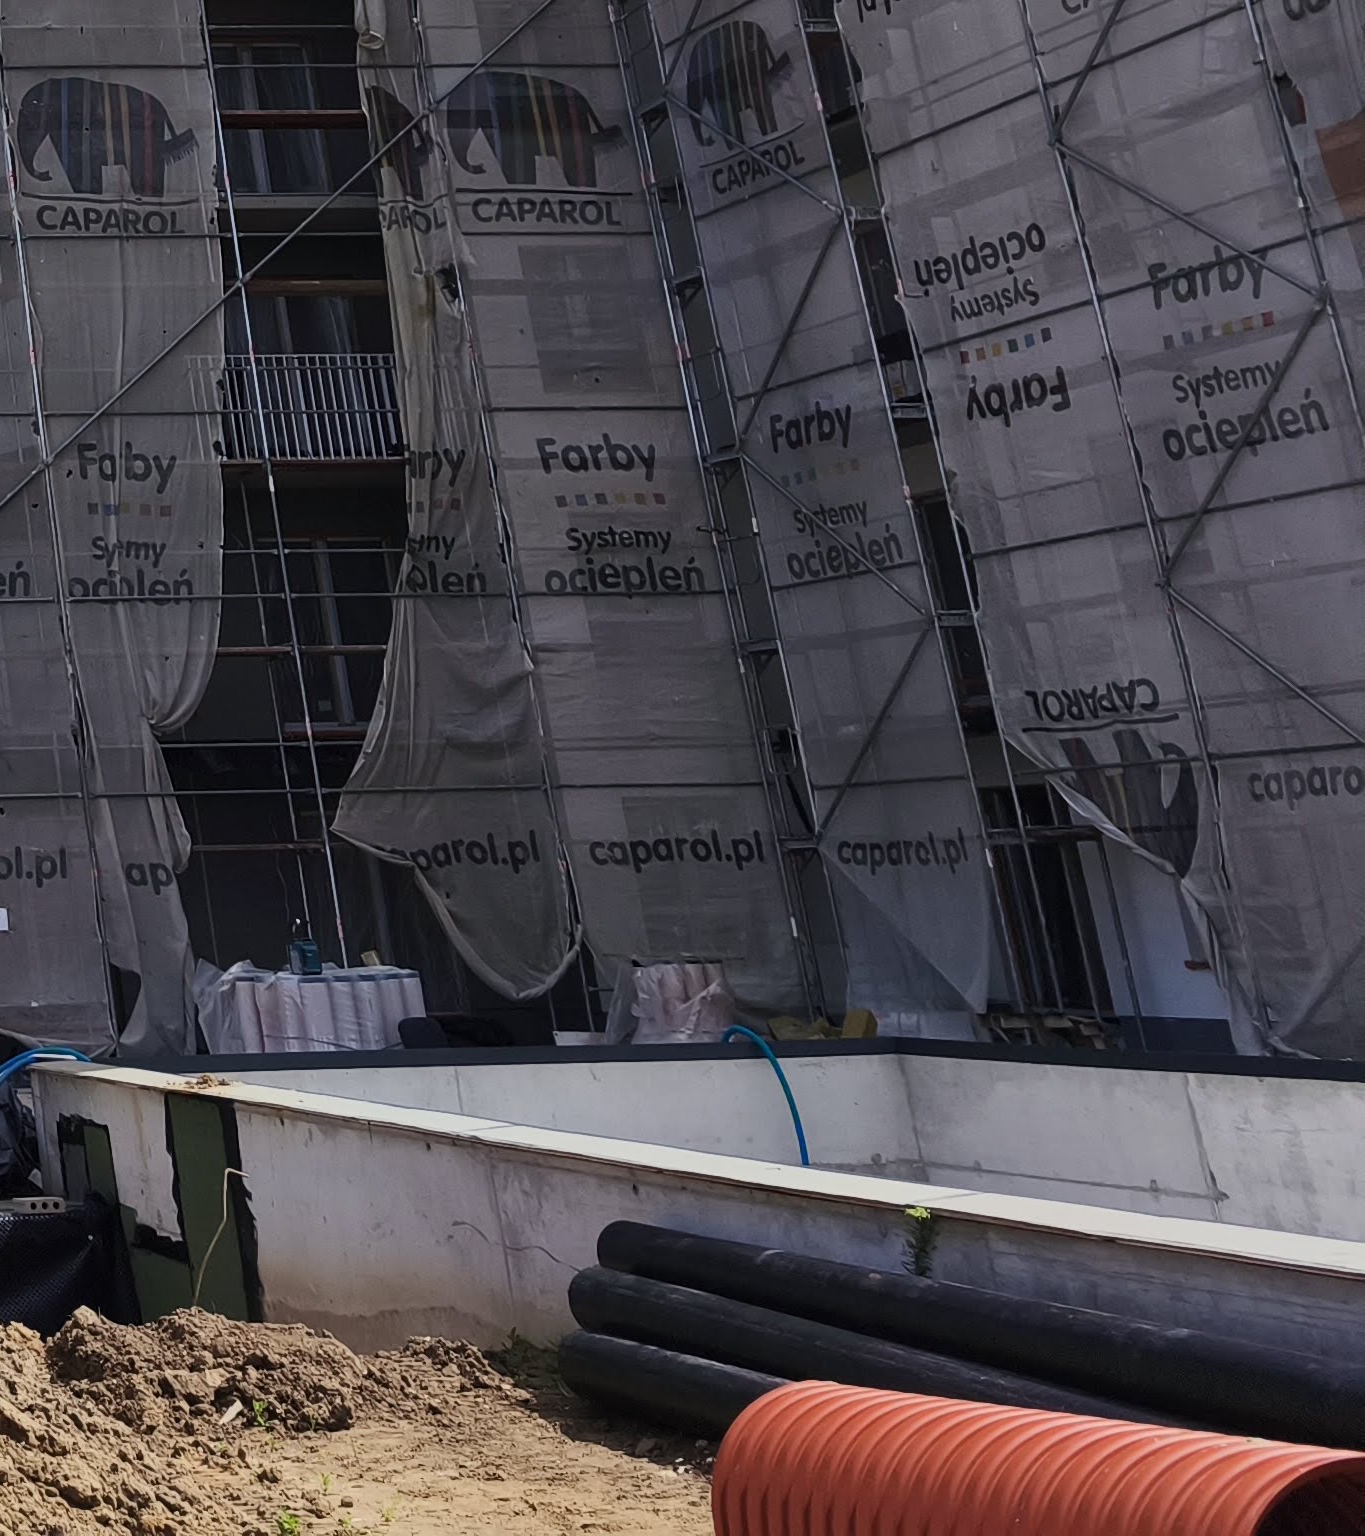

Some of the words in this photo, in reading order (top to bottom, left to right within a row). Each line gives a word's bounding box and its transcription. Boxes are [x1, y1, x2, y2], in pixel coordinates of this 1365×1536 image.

[710, 140, 806, 196] CAPAROL
[35, 204, 186, 236] CAPAROL
[471, 196, 622, 228] CAPAROL
[914, 222, 1047, 290] ociepleń
[1146, 244, 1269, 311] Farby
[949, 275, 1040, 324] Systemy
[966, 365, 1071, 427] Farby
[1171, 359, 1282, 406] Systemy
[769, 402, 852, 454] Farby
[1161, 387, 1330, 462] ociepleń
[536, 434, 656, 483] Farby
[566, 526, 672, 554] Systemy
[793, 499, 867, 535] Systemy
[544, 555, 705, 597] ociepleń
[787, 530, 903, 582] ociepleń
[1025, 677, 1160, 725] CAPAROL
[390, 828, 541, 875] parol.pl
[589, 829, 765, 870] caparol.pl
[837, 826, 967, 876] caparol.pl
